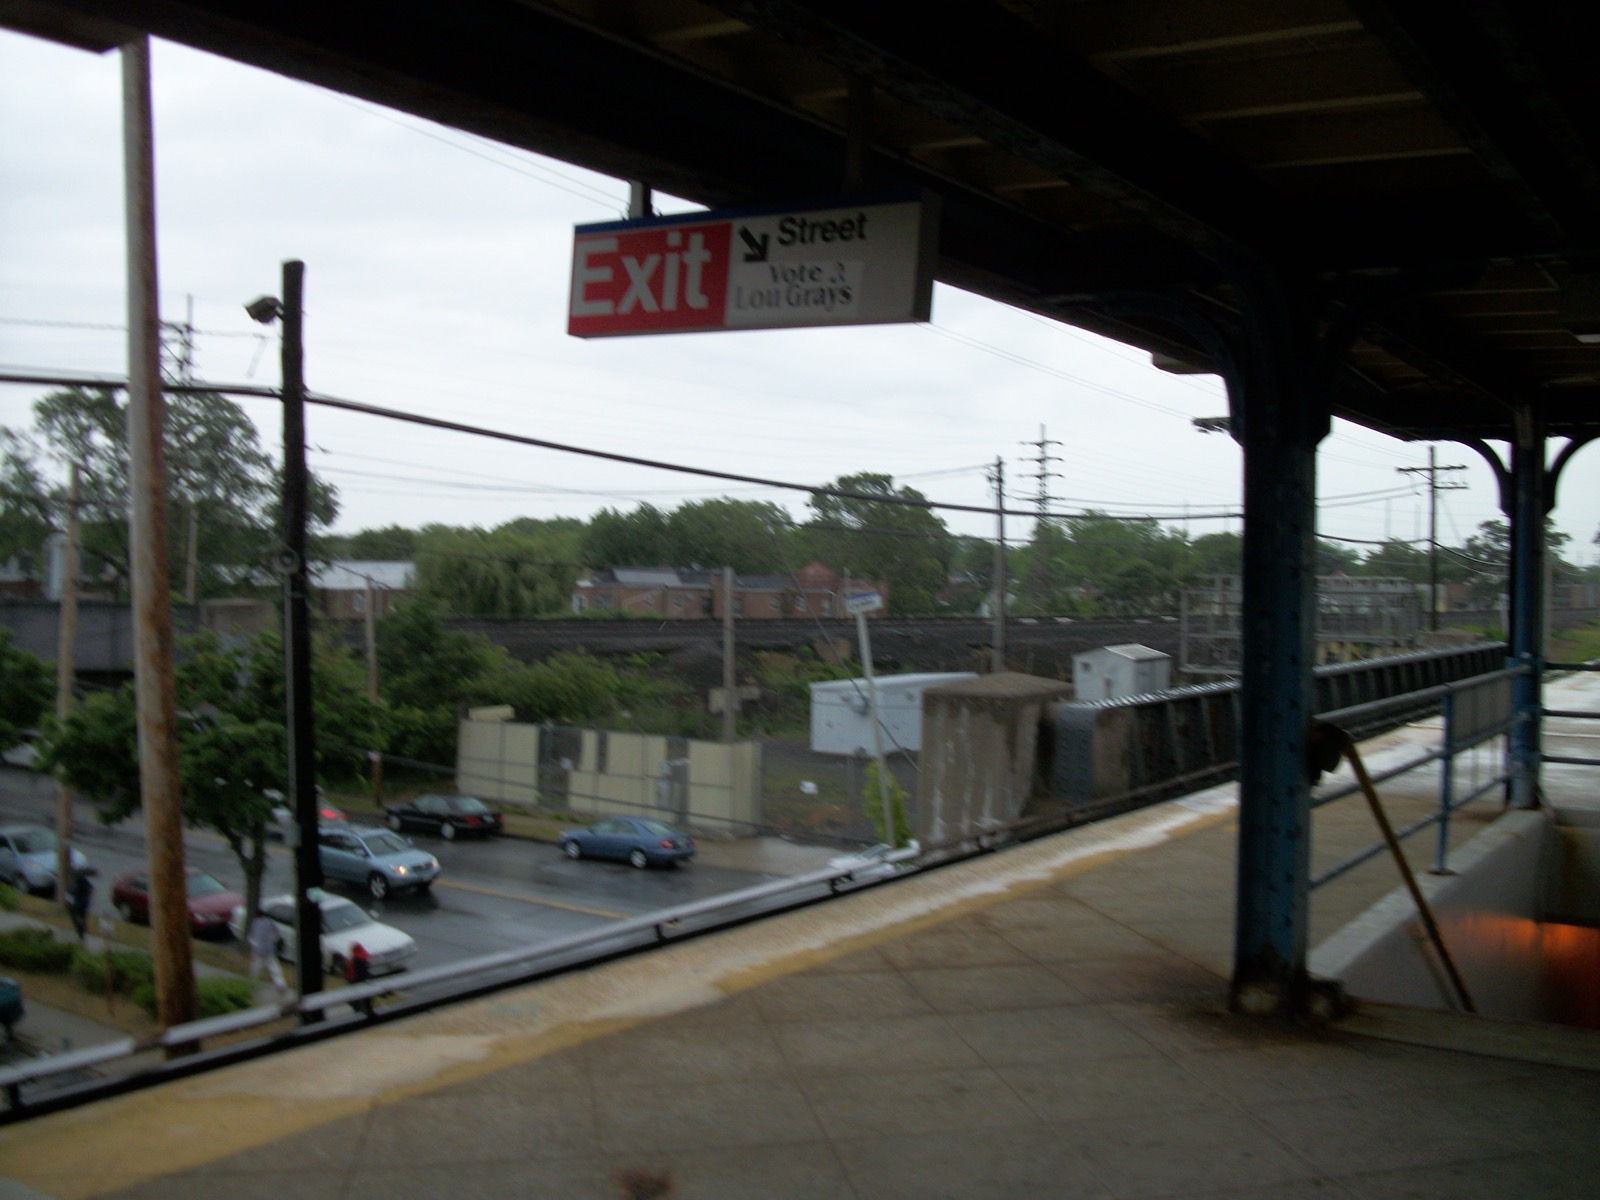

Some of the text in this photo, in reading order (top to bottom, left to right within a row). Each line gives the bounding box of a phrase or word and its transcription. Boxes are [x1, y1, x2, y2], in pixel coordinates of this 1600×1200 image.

[778, 212, 867, 246] Street
[572, 232, 711, 316] Exit
[769, 263, 823, 284] Vote
[735, 283, 853, 312] Lou Grays
